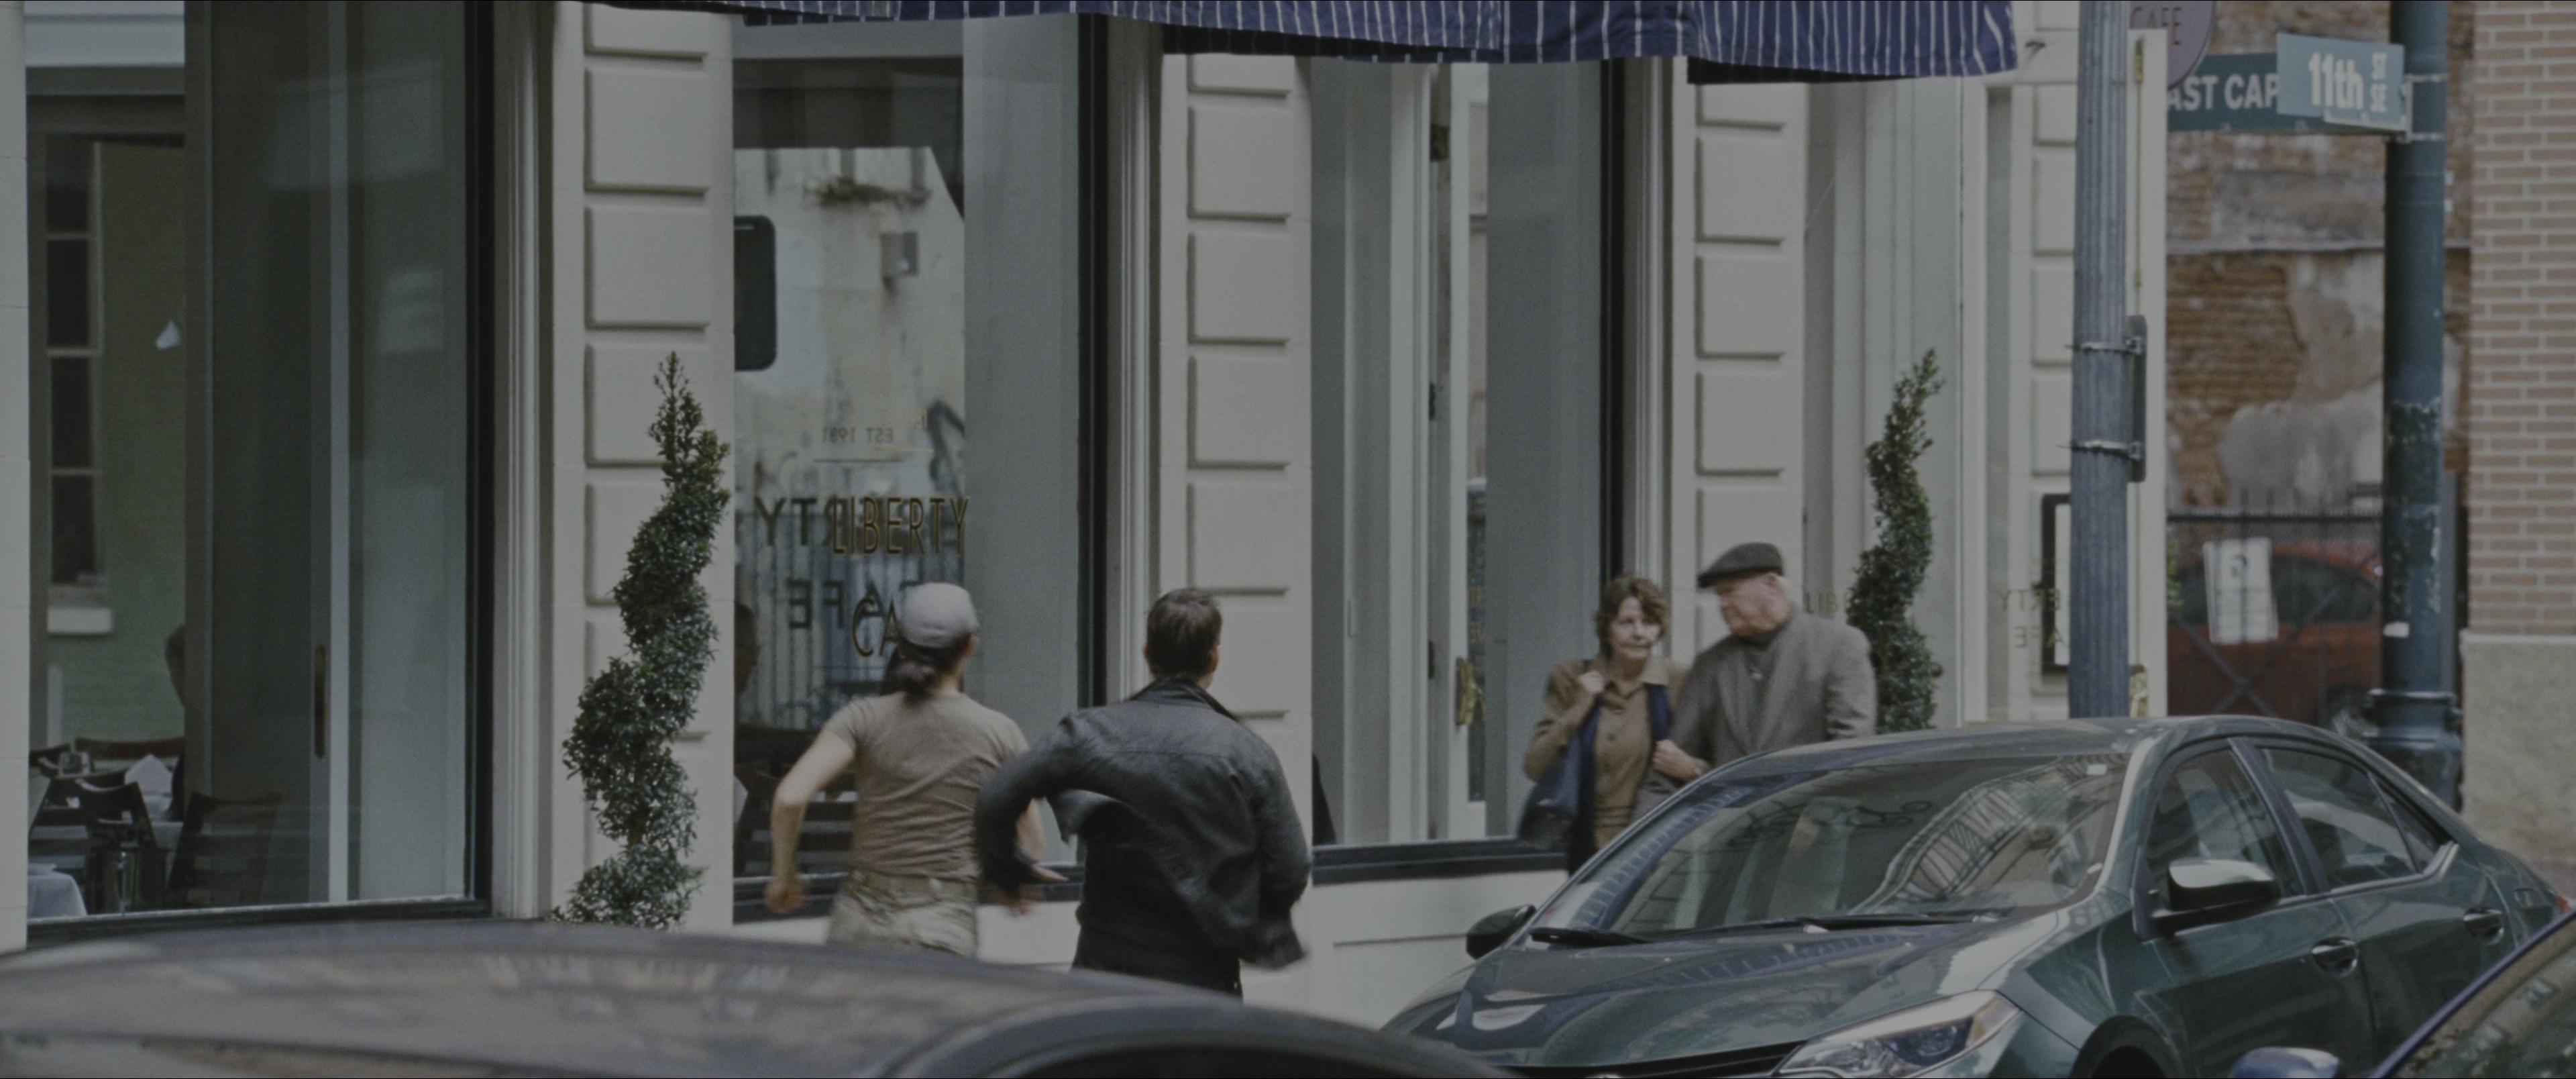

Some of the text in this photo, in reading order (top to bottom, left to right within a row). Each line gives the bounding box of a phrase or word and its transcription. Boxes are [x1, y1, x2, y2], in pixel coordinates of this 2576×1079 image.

[2167, 73, 2279, 111] AST CAP
[2308, 52, 2364, 110] 11th
[831, 495, 971, 556] LIBERTY
[851, 595, 902, 658] CA
